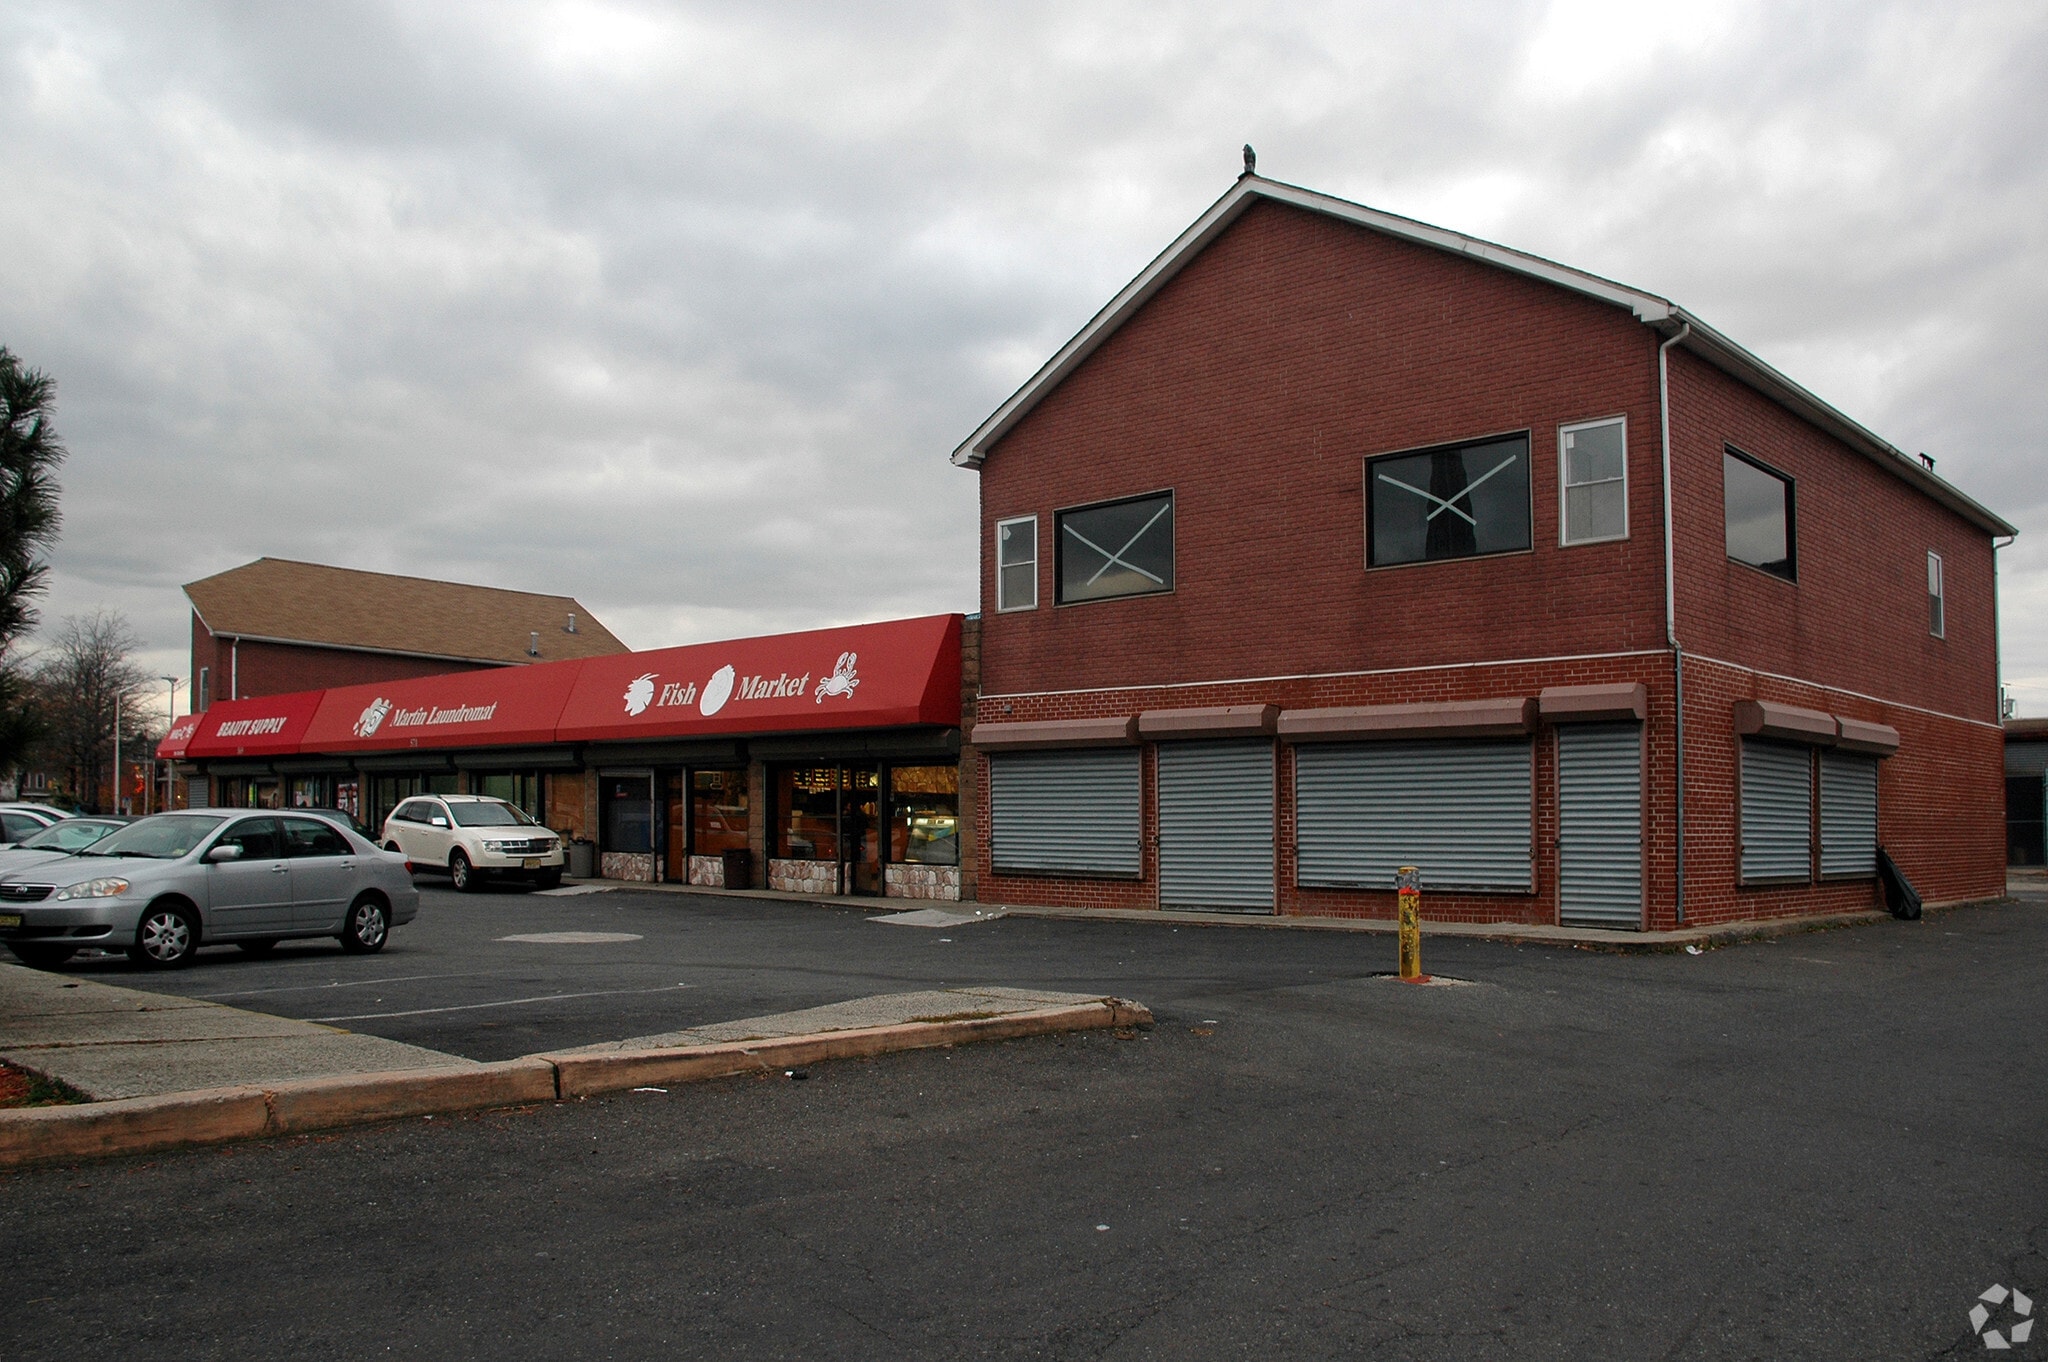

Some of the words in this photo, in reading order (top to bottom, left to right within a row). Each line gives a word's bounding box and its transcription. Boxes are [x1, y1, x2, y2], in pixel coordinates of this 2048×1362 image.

[656, 682, 697, 707] Fish
[734, 672, 810, 701] Market
[216, 720, 252, 737] BEAUTY
[248, 717, 287, 736] SUPPLY
[389, 707, 428, 727] Martin
[426, 701, 498, 725] Laundromat
